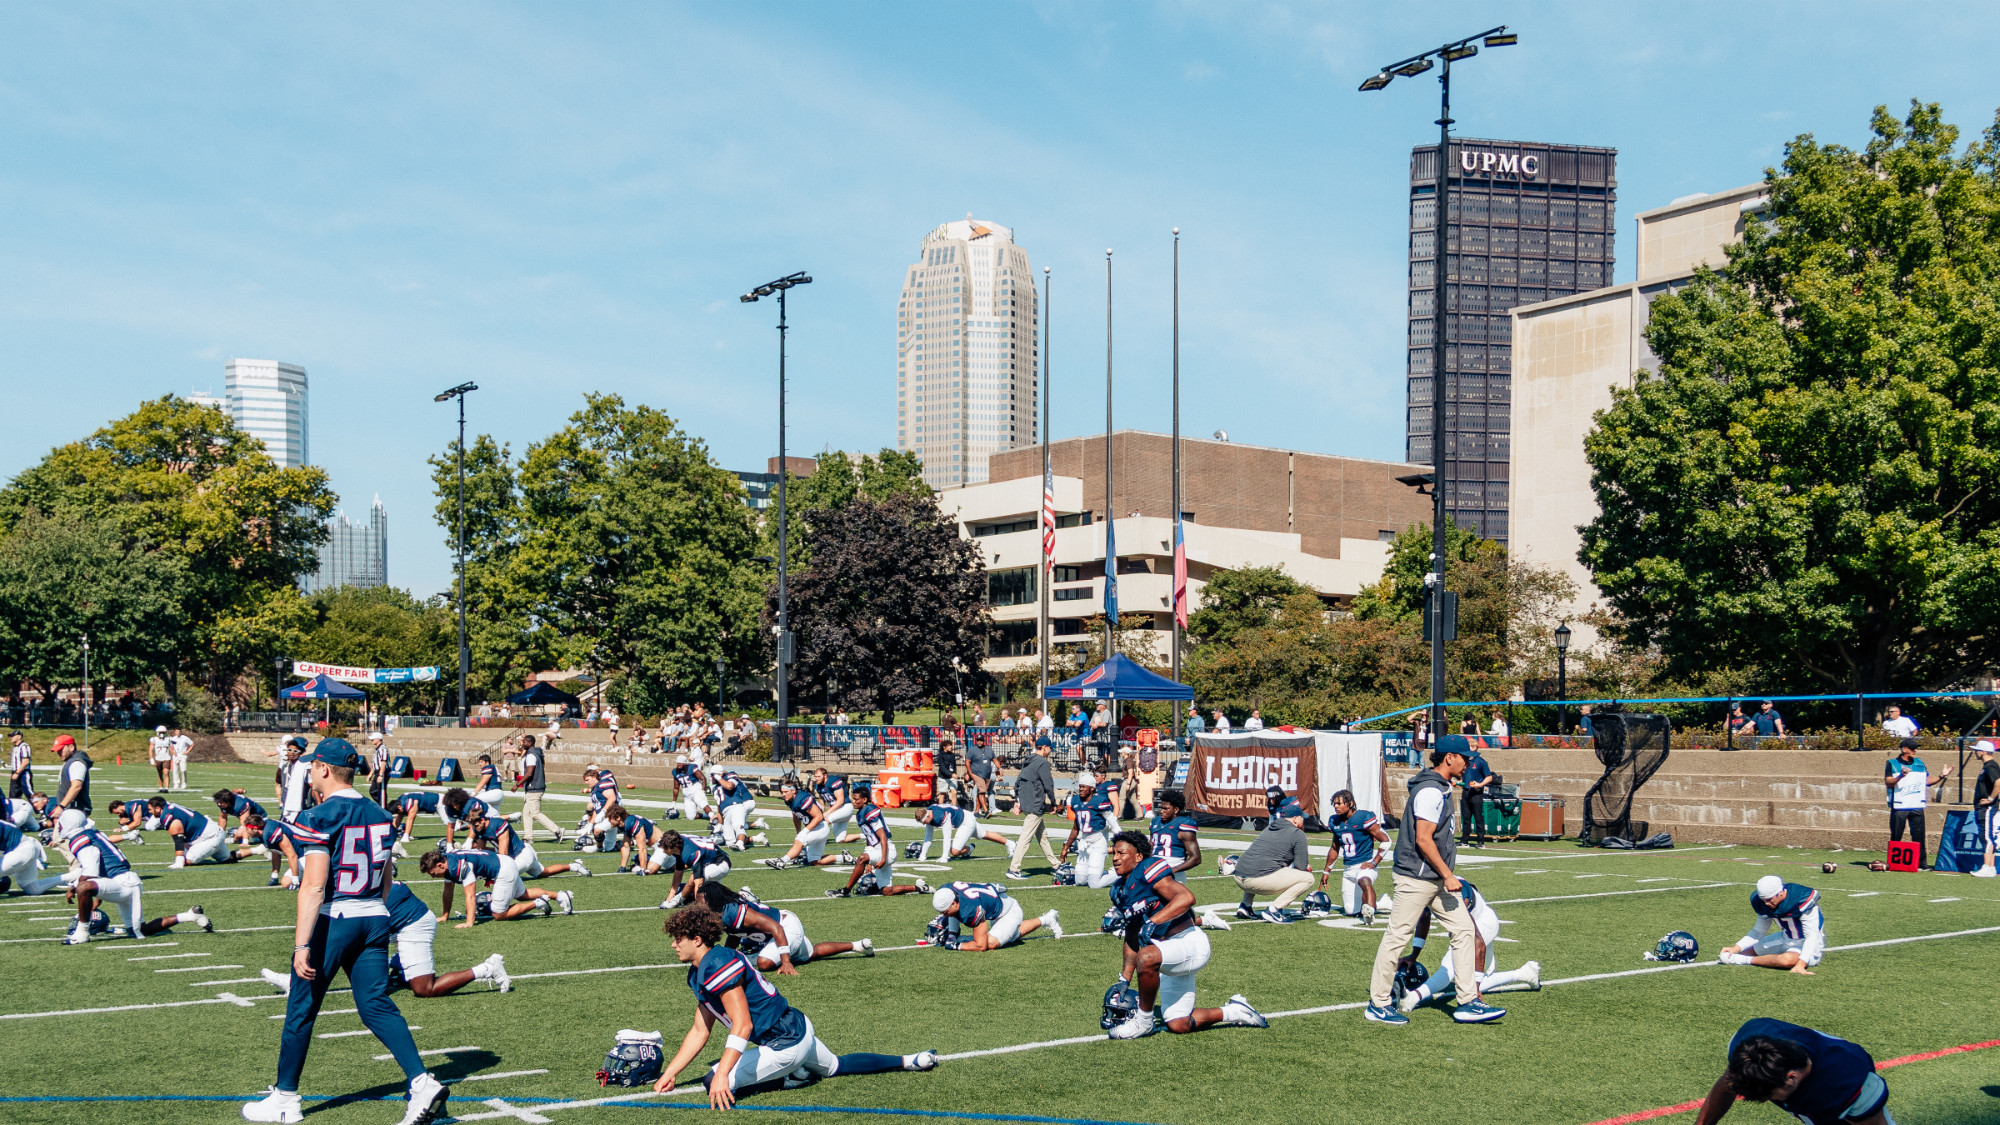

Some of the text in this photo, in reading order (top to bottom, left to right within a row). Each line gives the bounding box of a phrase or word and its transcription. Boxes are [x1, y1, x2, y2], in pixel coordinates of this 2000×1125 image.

[1460, 151, 1538, 174] UPMC
[300, 663, 342, 677] CAREER
[345, 668, 369, 678] FAIR
[1385, 747, 1408, 756] PLAN
[1205, 755, 1299, 791] LEHIGH
[1206, 793, 1244, 809] SPORTS
[1077, 810, 1093, 833] 12
[1341, 832, 1357, 858] 0
[336, 823, 391, 895] 55
[1891, 847, 1913, 866] 20
[640, 1045, 656, 1061] 84
